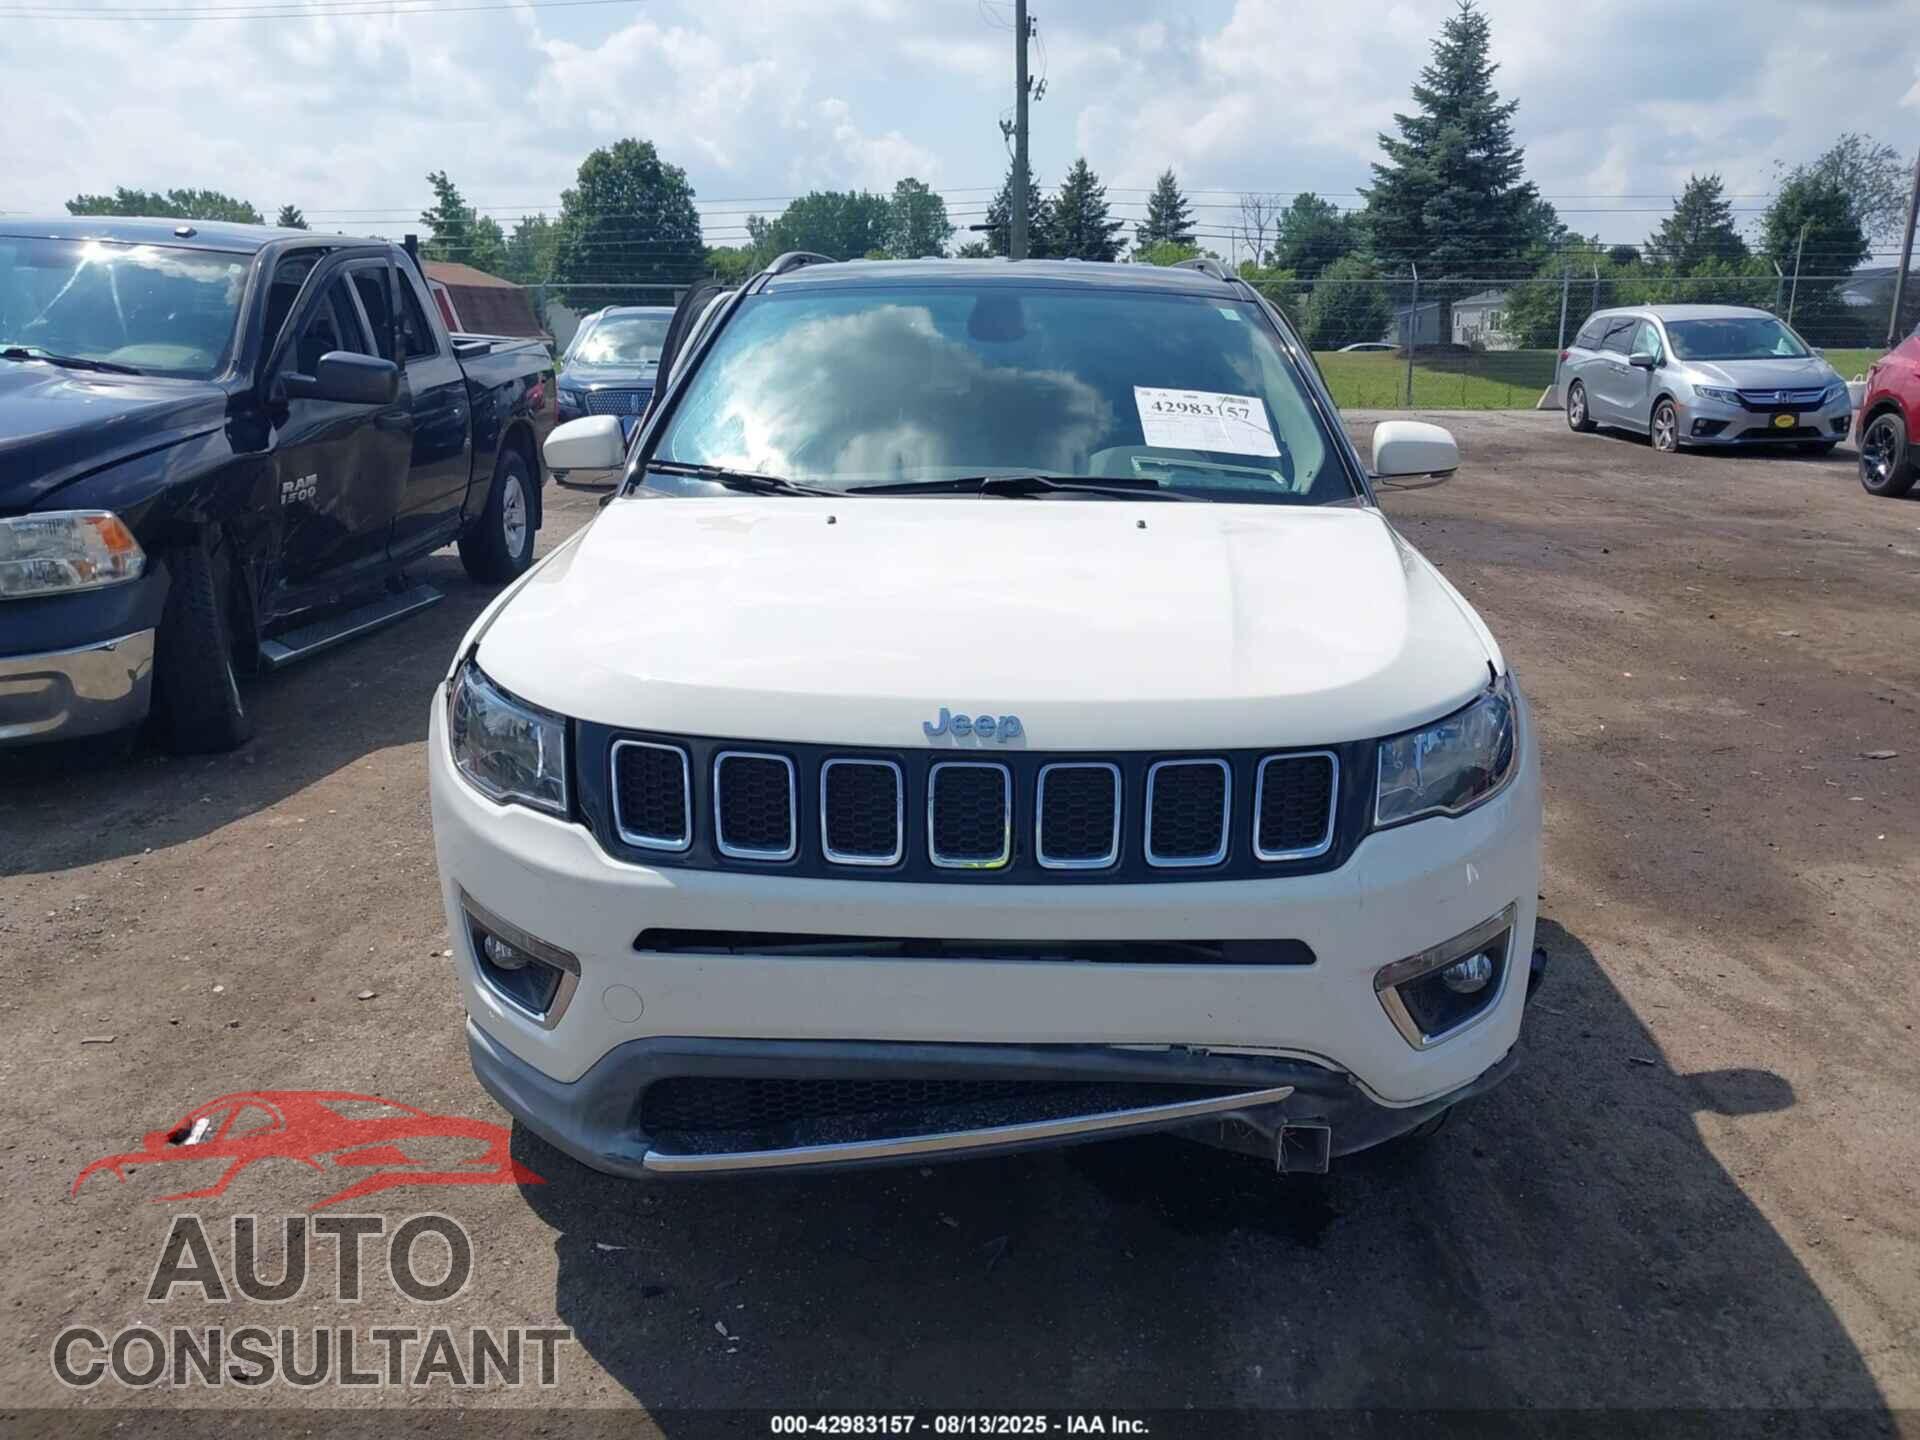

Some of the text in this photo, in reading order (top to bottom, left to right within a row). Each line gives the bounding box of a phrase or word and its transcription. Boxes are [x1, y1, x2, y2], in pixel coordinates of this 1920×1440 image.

[282, 473, 318, 494] RAM
[280, 486, 317, 505] 1500
[922, 706, 1024, 744] Jeep
